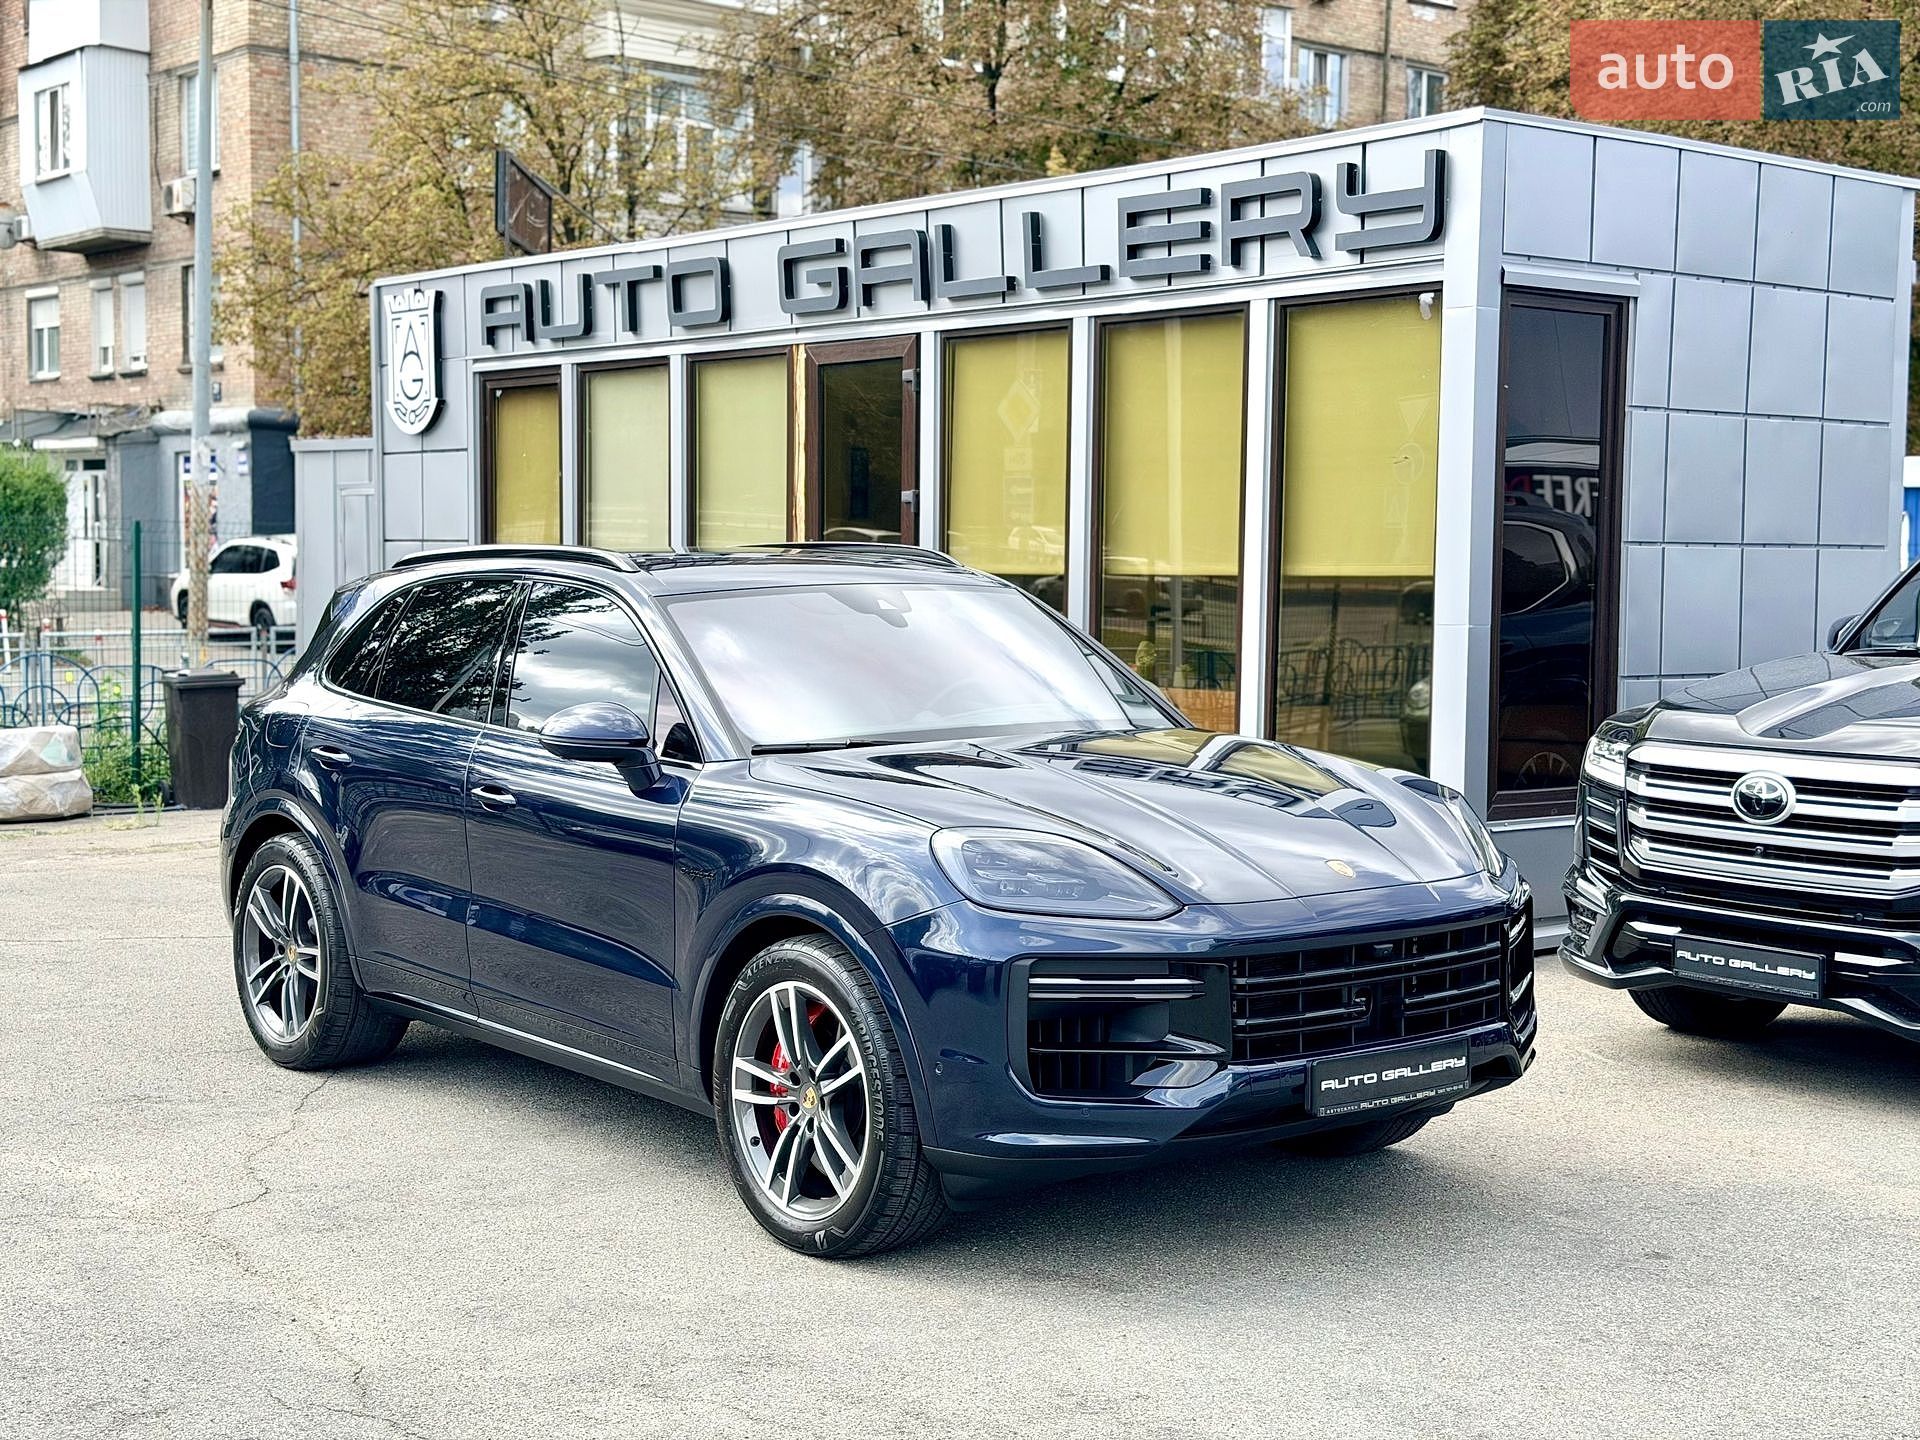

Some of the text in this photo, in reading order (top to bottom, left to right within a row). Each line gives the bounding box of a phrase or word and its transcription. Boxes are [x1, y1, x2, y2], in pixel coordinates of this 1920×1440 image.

[481, 149, 1447, 346] AUTO GALLERY
[1676, 950, 1816, 980] AUTO GALLERY
[1320, 1056, 1466, 1091] AUTO GALLERY
[1360, 1098, 1389, 1109] AUTO
[1390, 1089, 1436, 1105] GALLERY
